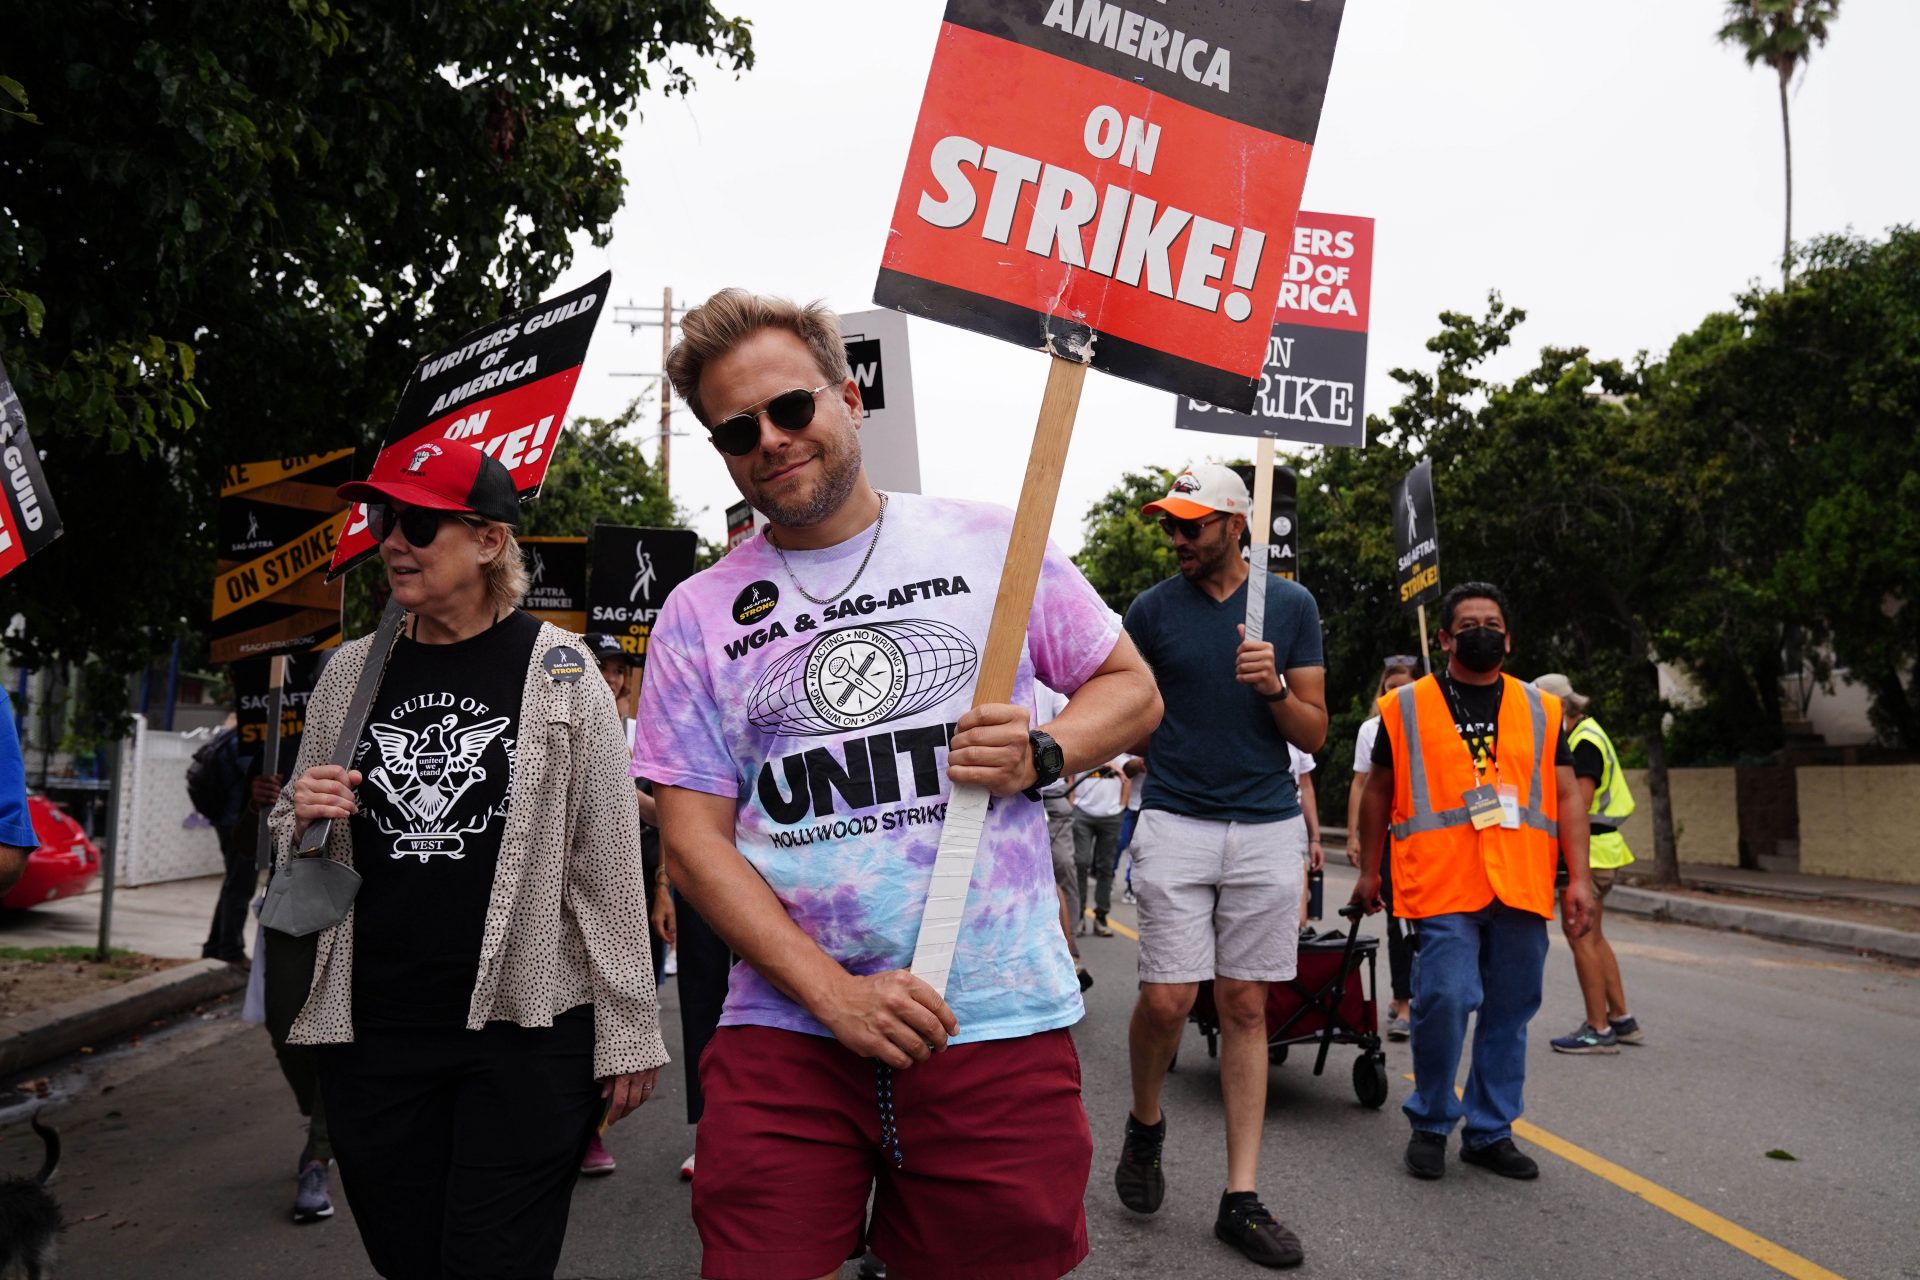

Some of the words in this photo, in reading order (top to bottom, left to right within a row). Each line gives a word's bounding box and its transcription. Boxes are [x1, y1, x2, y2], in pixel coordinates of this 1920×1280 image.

[1042, 0, 1231, 93] AMERICA
[1083, 104, 1162, 176] ON
[917, 135, 1267, 323] STRIKE!
[1314, 264, 1350, 286] OF
[1278, 282, 1358, 317] RICA
[420, 322, 521, 382] WRITERS
[523, 293, 598, 336] GUILD
[480, 347, 508, 371] OF
[849, 361, 878, 388] W
[427, 355, 539, 418] AMERICA
[443, 409, 491, 441] ON
[3, 446, 43, 532] GUILD
[226, 567, 260, 603] ON
[262, 524, 337, 586] STRIKE
[1400, 564, 1438, 602] STRIKE!
[526, 597, 573, 608] STRIKE!
[724, 621, 788, 661] WGA
[794, 613, 819, 632] &
[823, 576, 971, 622] SAG-AFTRA
[739, 600, 775, 620] STRONG
[629, 624, 650, 636] ON
[808, 663, 818, 679] NO
[814, 633, 845, 662] ACTING
[854, 630, 869, 640] NO
[872, 633, 902, 667] WRITING
[551, 667, 583, 675] STRONG
[895, 675, 903, 691] NO
[390, 692, 455, 720] GUILD
[460, 697, 490, 717] OF
[810, 688, 841, 724] WRITING
[843, 717, 858, 725] NO
[867, 692, 898, 718] ACTING
[418, 756, 444, 764] united
[420, 768, 441, 777] stand
[758, 722, 957, 825] UNIT
[410, 840, 444, 850] WEST
[769, 815, 878, 849] HOLLYWOOD
